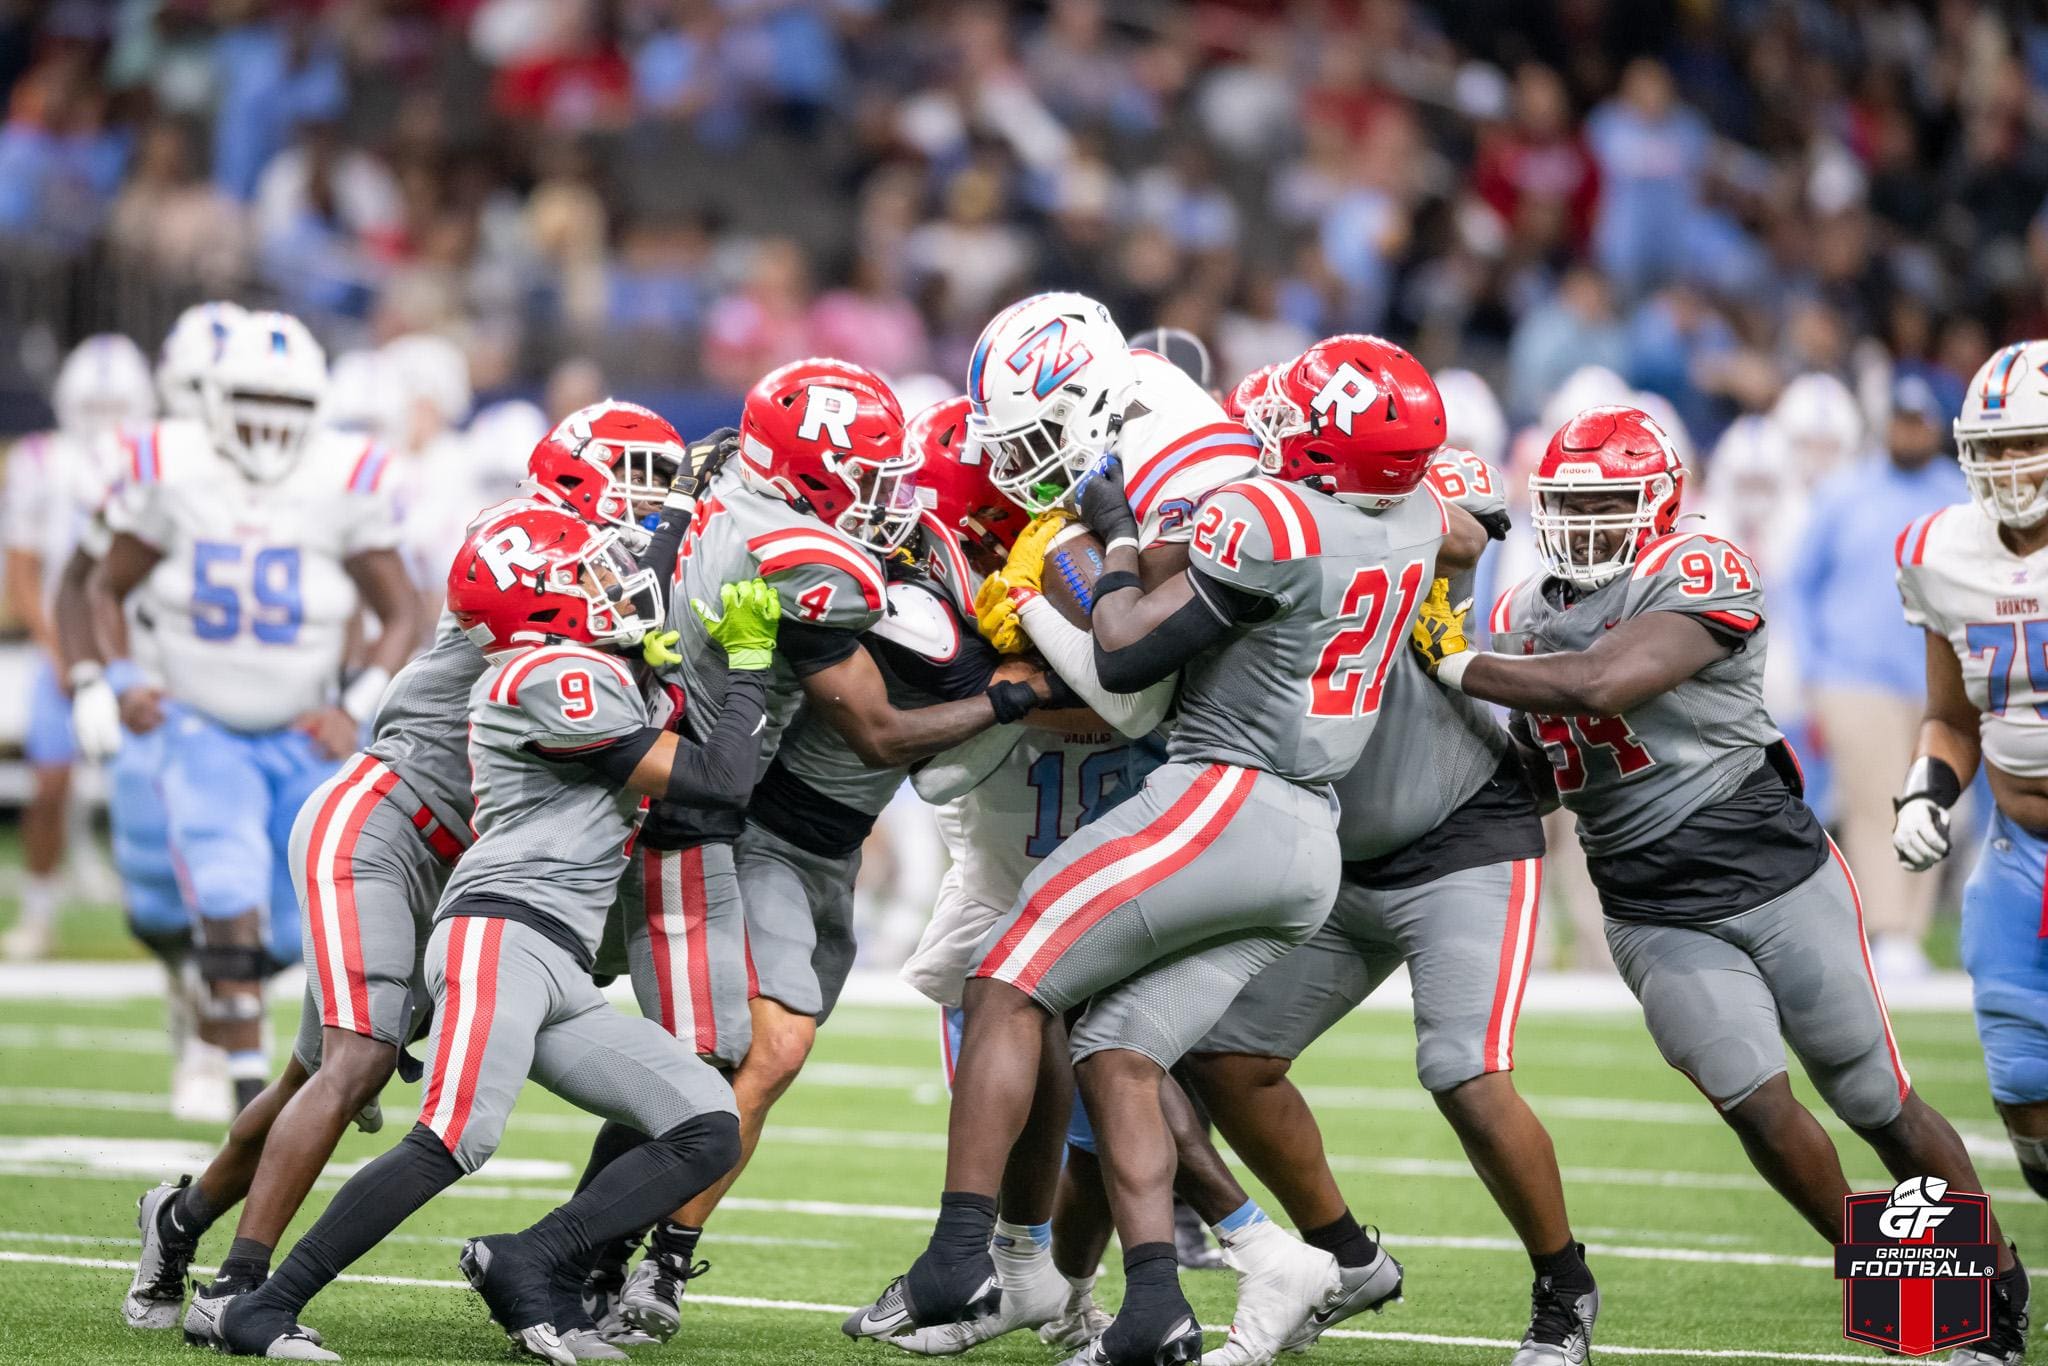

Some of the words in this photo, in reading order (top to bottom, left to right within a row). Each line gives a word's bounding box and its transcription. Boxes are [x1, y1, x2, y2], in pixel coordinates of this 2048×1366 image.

[796, 384, 852, 449] R
[1309, 361, 1379, 437] R
[1427, 453, 1494, 501] 63
[476, 525, 549, 592] R
[1191, 503, 1252, 573] 21
[192, 540, 304, 645] 59
[796, 581, 838, 622] 4
[1677, 549, 1753, 598] 94
[1306, 559, 1425, 718] 21
[1995, 597, 2039, 616] BRONCOS
[556, 668, 598, 723] 9
